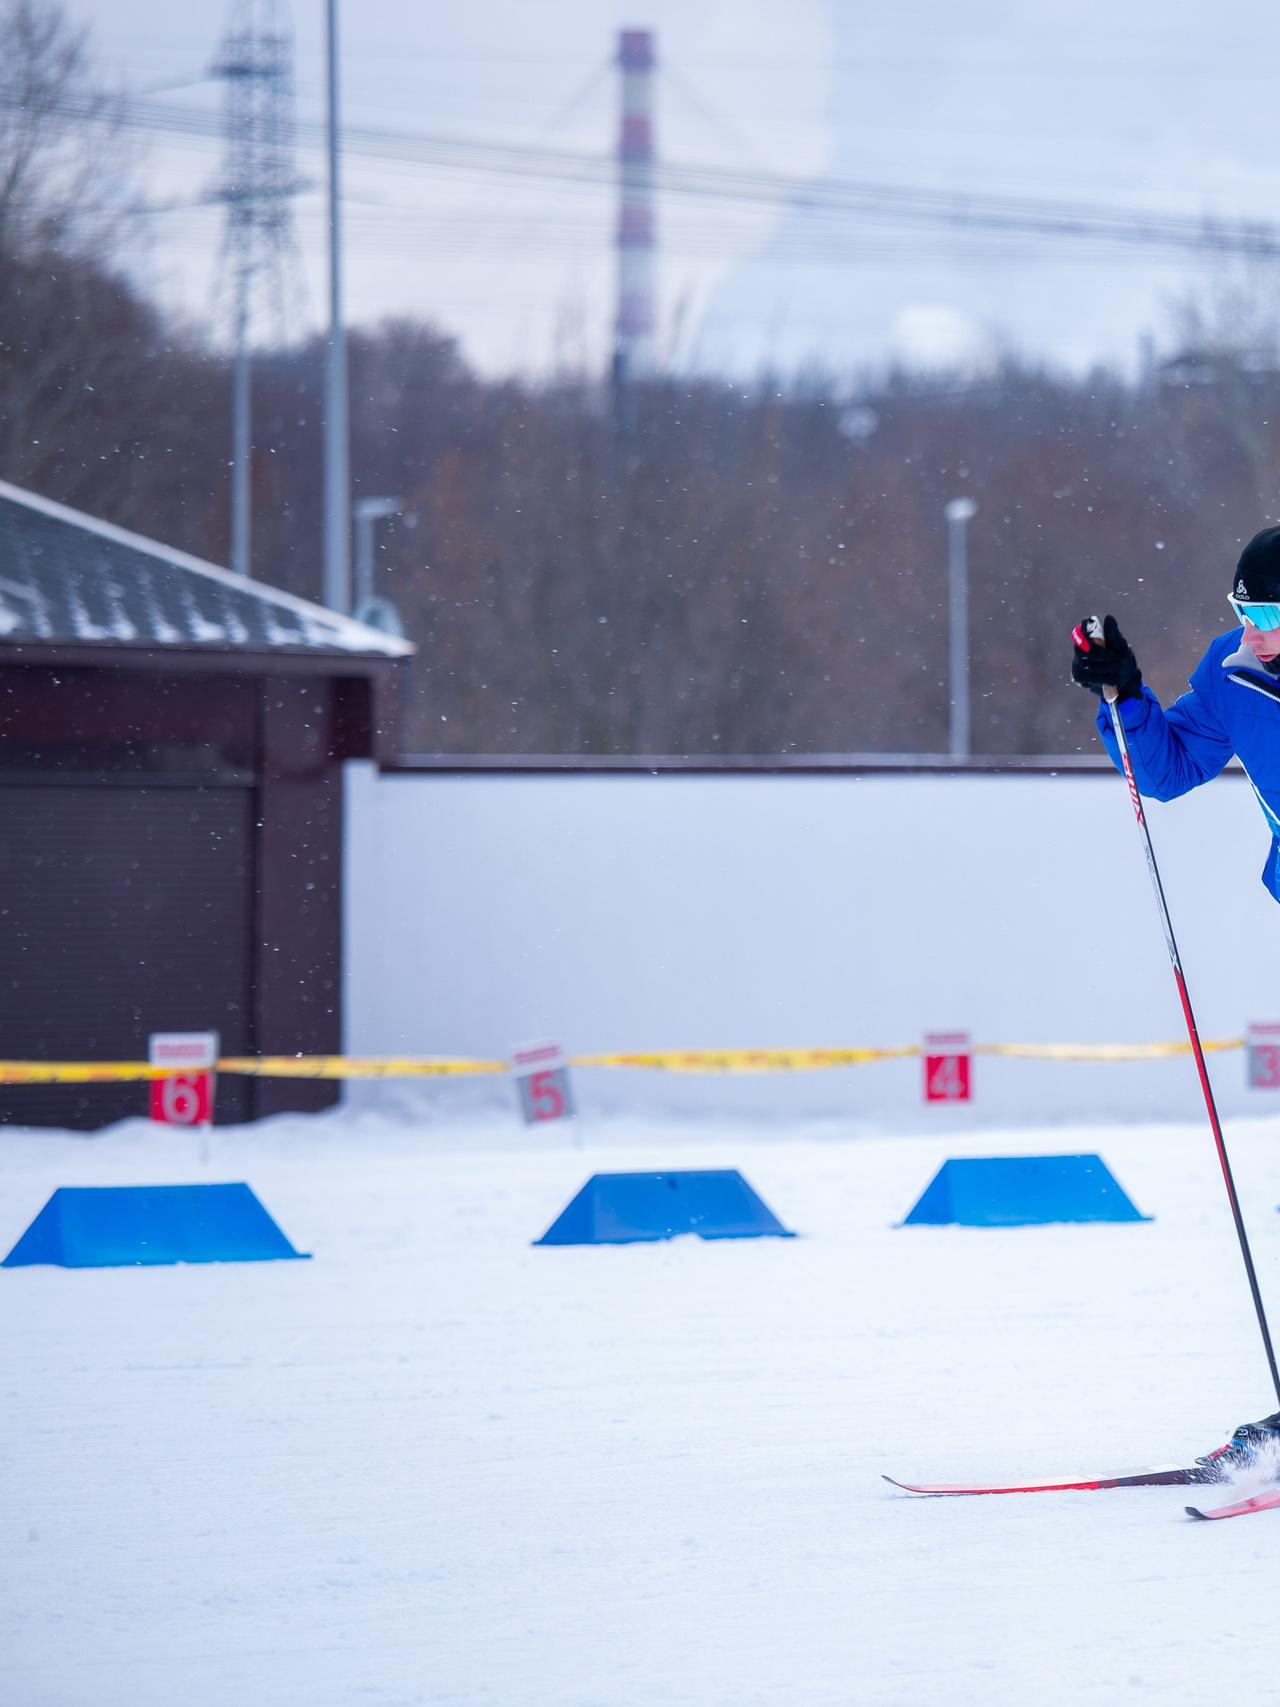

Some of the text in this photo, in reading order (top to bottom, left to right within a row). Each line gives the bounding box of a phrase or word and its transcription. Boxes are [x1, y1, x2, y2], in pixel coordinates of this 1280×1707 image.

[162, 1071, 200, 1125] 6
[529, 1069, 565, 1121] 5
[930, 1057, 965, 1100] 4
